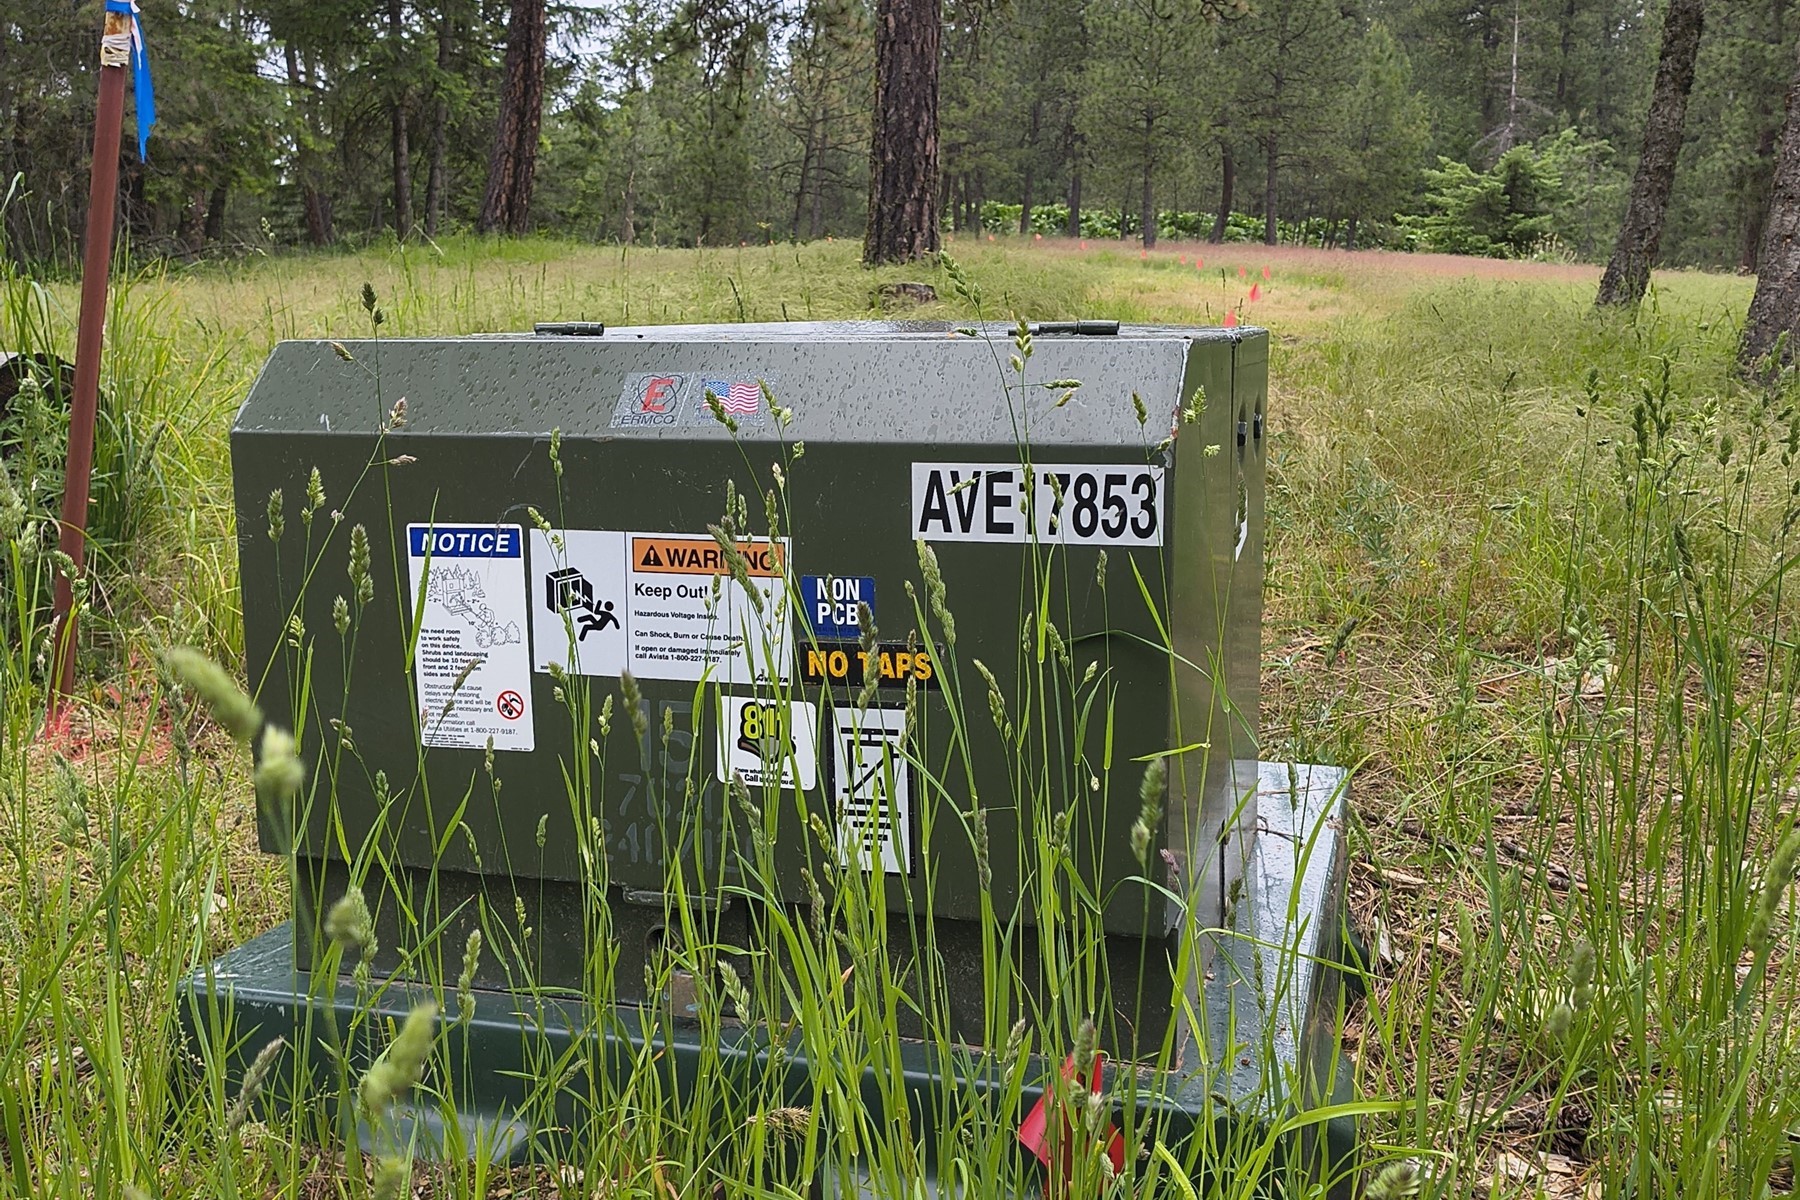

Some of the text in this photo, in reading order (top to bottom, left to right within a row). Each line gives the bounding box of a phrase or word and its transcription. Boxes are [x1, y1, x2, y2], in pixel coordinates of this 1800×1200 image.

[621, 415, 674, 424] ERMCO
[918, 470, 1157, 539] AVE17853
[421, 533, 510, 553] NOTICE
[635, 583, 708, 600] Keep Out!
[817, 578, 860, 601] NON
[634, 610, 670, 618] Hazardous
[671, 611, 695, 620] Voltage
[817, 602, 860, 626] PCB
[650, 631, 672, 639] Shock,
[668, 647, 699, 655] damaged
[808, 650, 848, 678] NO
[744, 774, 758, 782] Call
